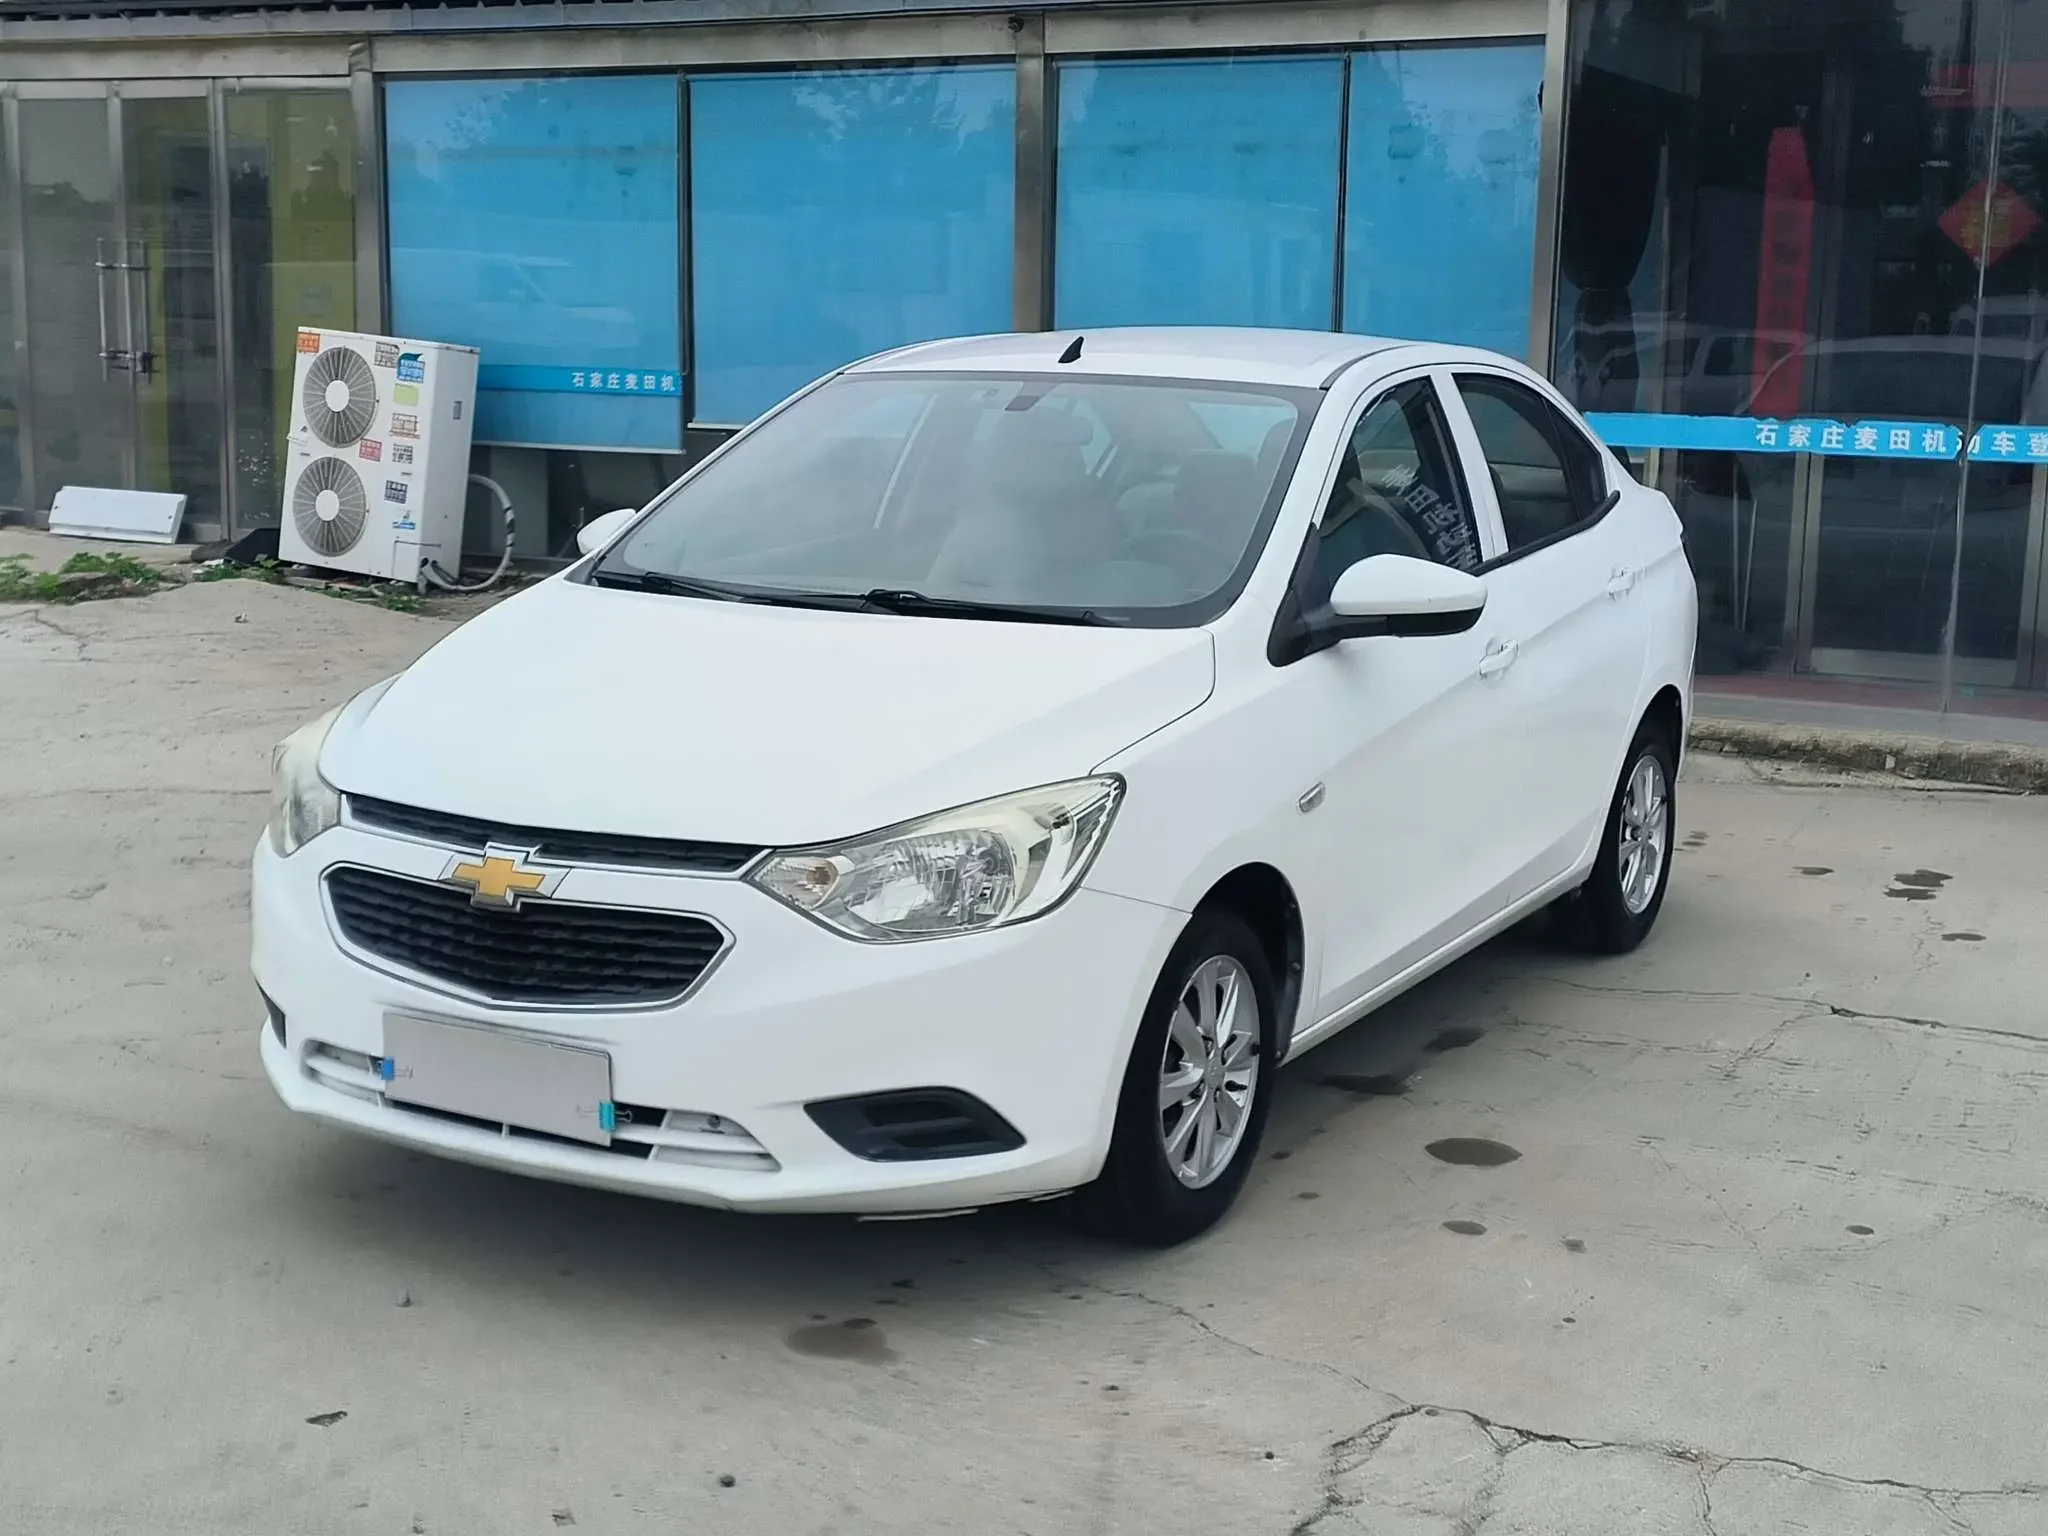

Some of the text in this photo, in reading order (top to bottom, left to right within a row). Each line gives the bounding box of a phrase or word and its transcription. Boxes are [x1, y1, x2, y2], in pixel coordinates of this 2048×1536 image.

[572, 371, 676, 392] 石家庄麦田机
